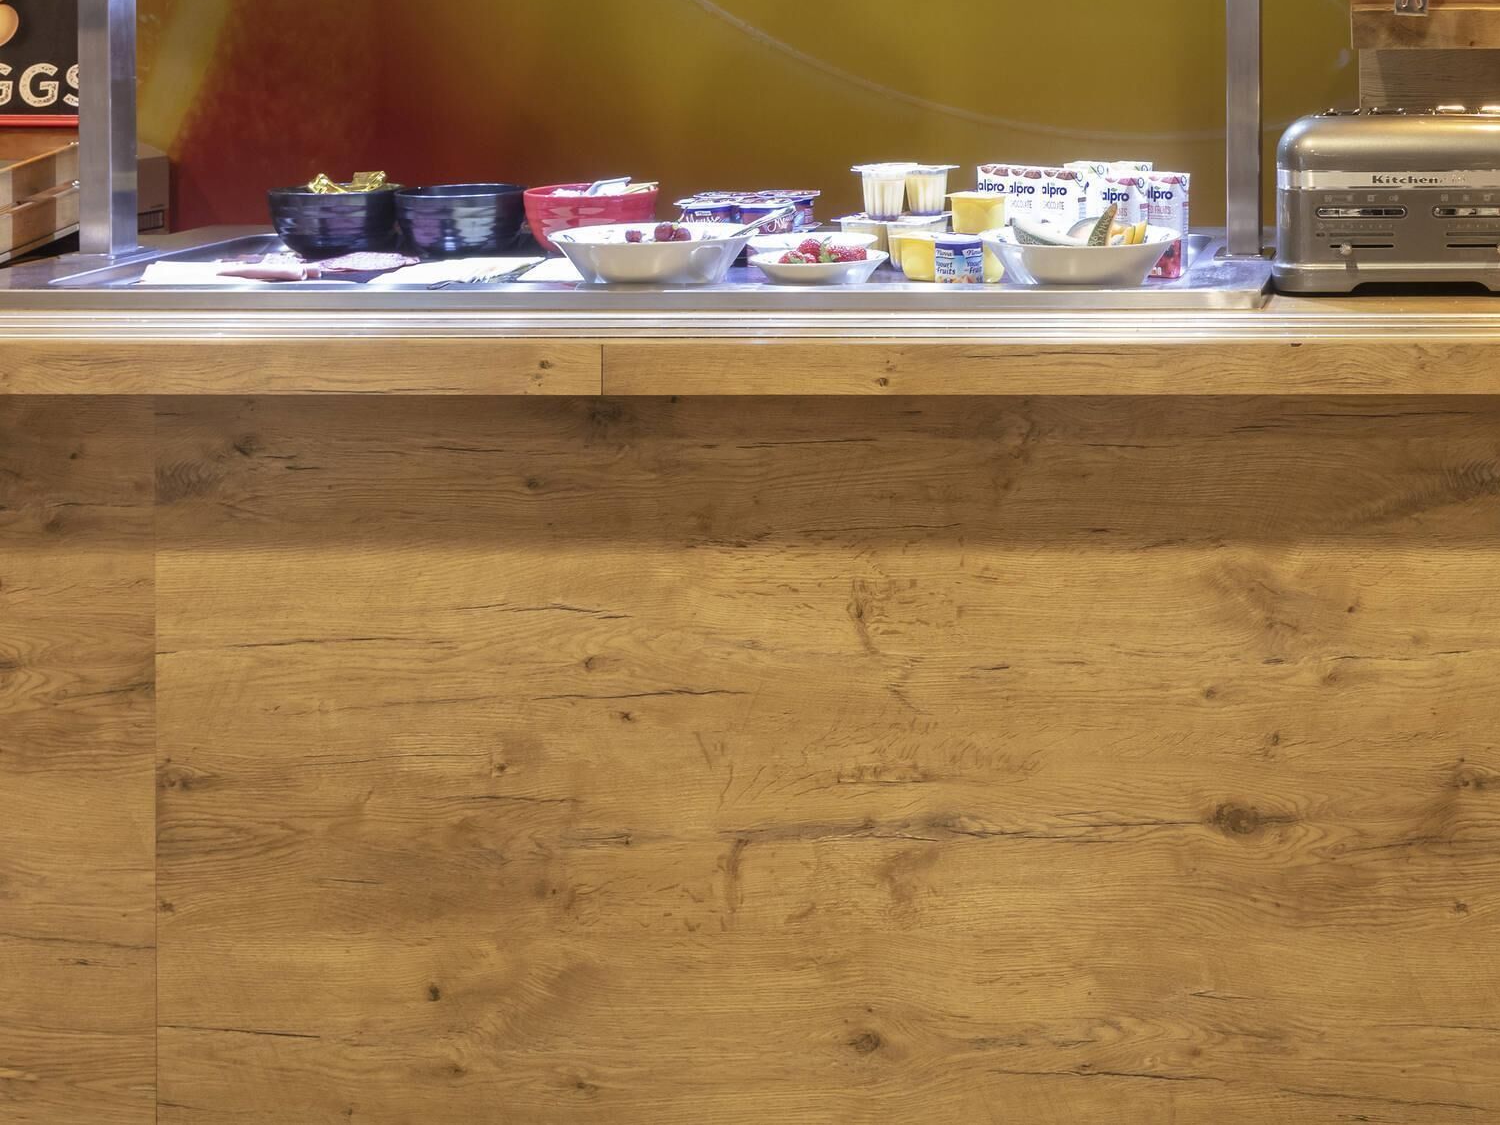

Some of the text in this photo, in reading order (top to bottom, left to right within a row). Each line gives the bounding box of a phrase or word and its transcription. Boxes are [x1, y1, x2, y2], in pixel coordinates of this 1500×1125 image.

[978, 179, 1005, 192] alpro
[1372, 175, 1440, 184] Kitchen
[1010, 181, 1035, 197] alpro
[1042, 182, 1067, 198] alpro
[1102, 188, 1130, 204] alpro
